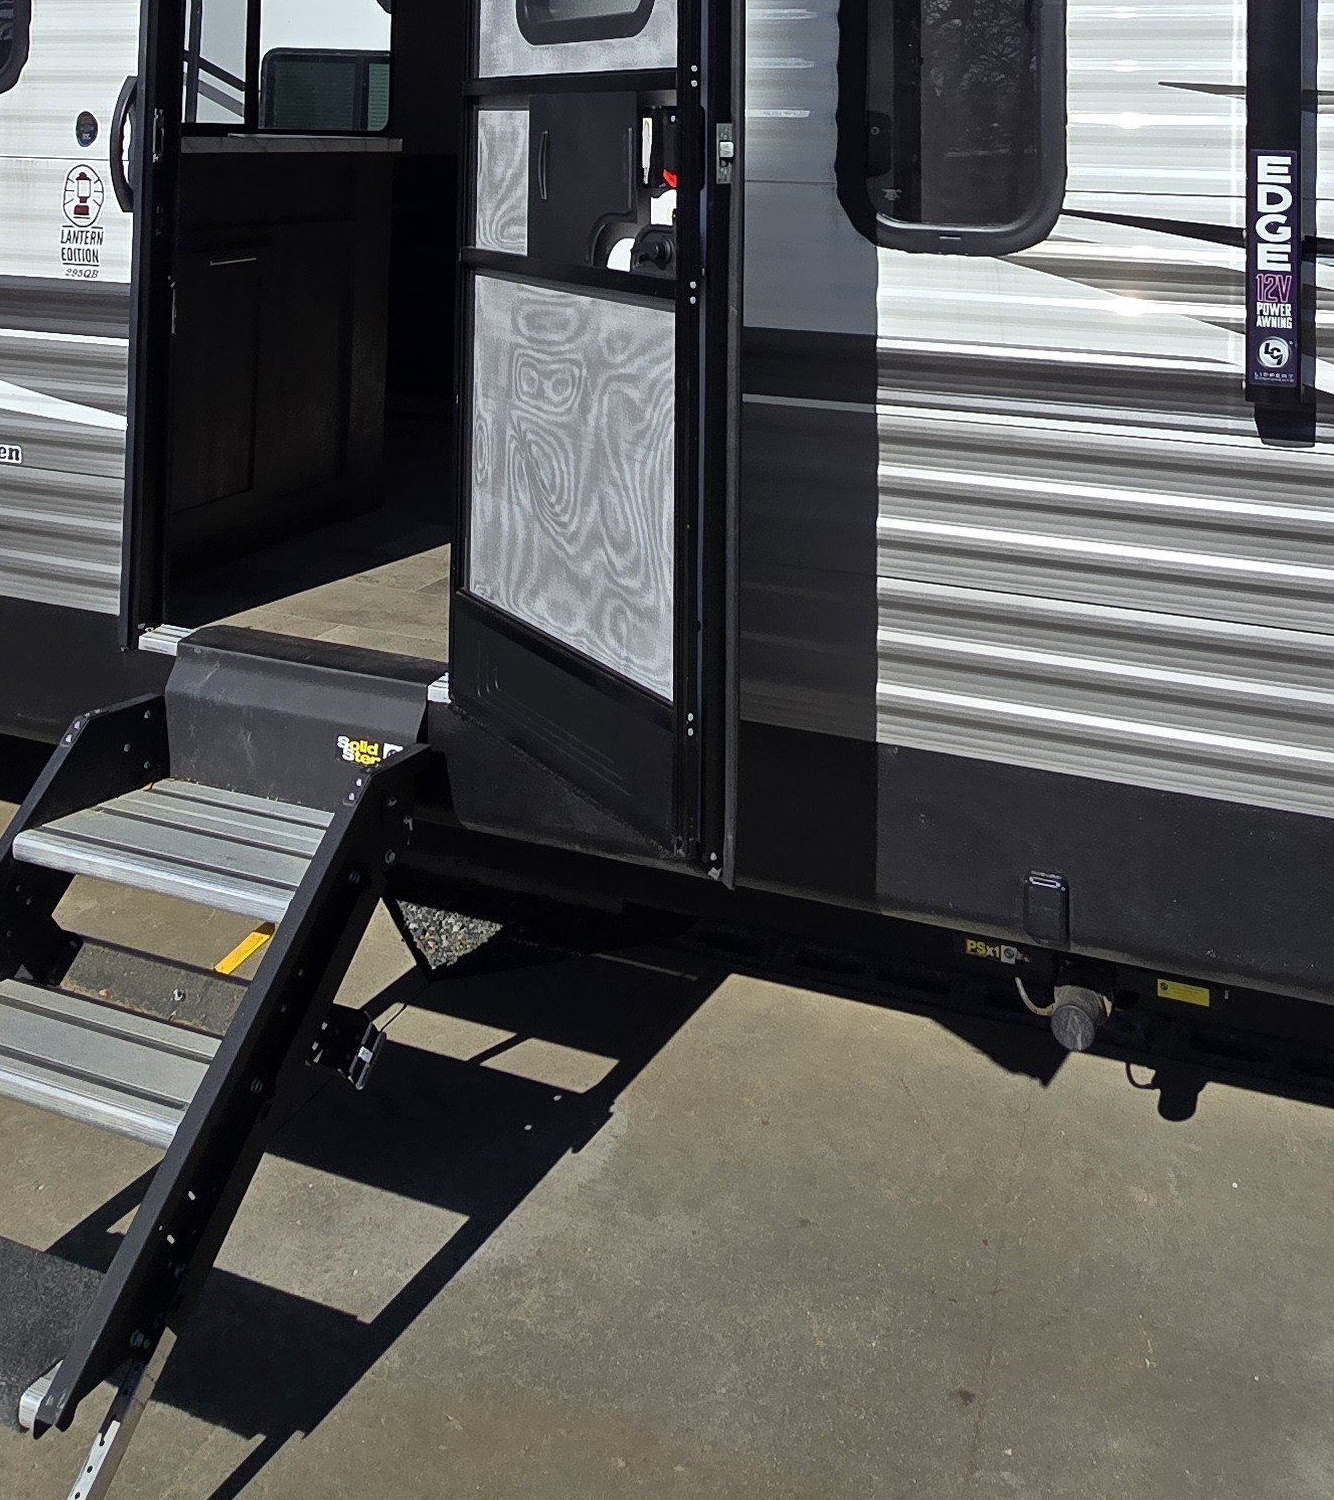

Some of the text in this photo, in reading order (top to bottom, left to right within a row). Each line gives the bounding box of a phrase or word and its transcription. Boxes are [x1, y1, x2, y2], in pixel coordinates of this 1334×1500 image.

[1255, 155, 1293, 272] EDGE
[60, 228, 104, 246] LANTERN
[61, 247, 100, 264] EDITION
[64, 267, 100, 279] 295QB
[1255, 273, 1293, 304] 12V
[1256, 301, 1292, 317] POWER
[1256, 315, 1293, 330] AWNING
[337, 735, 379, 756] Solid
